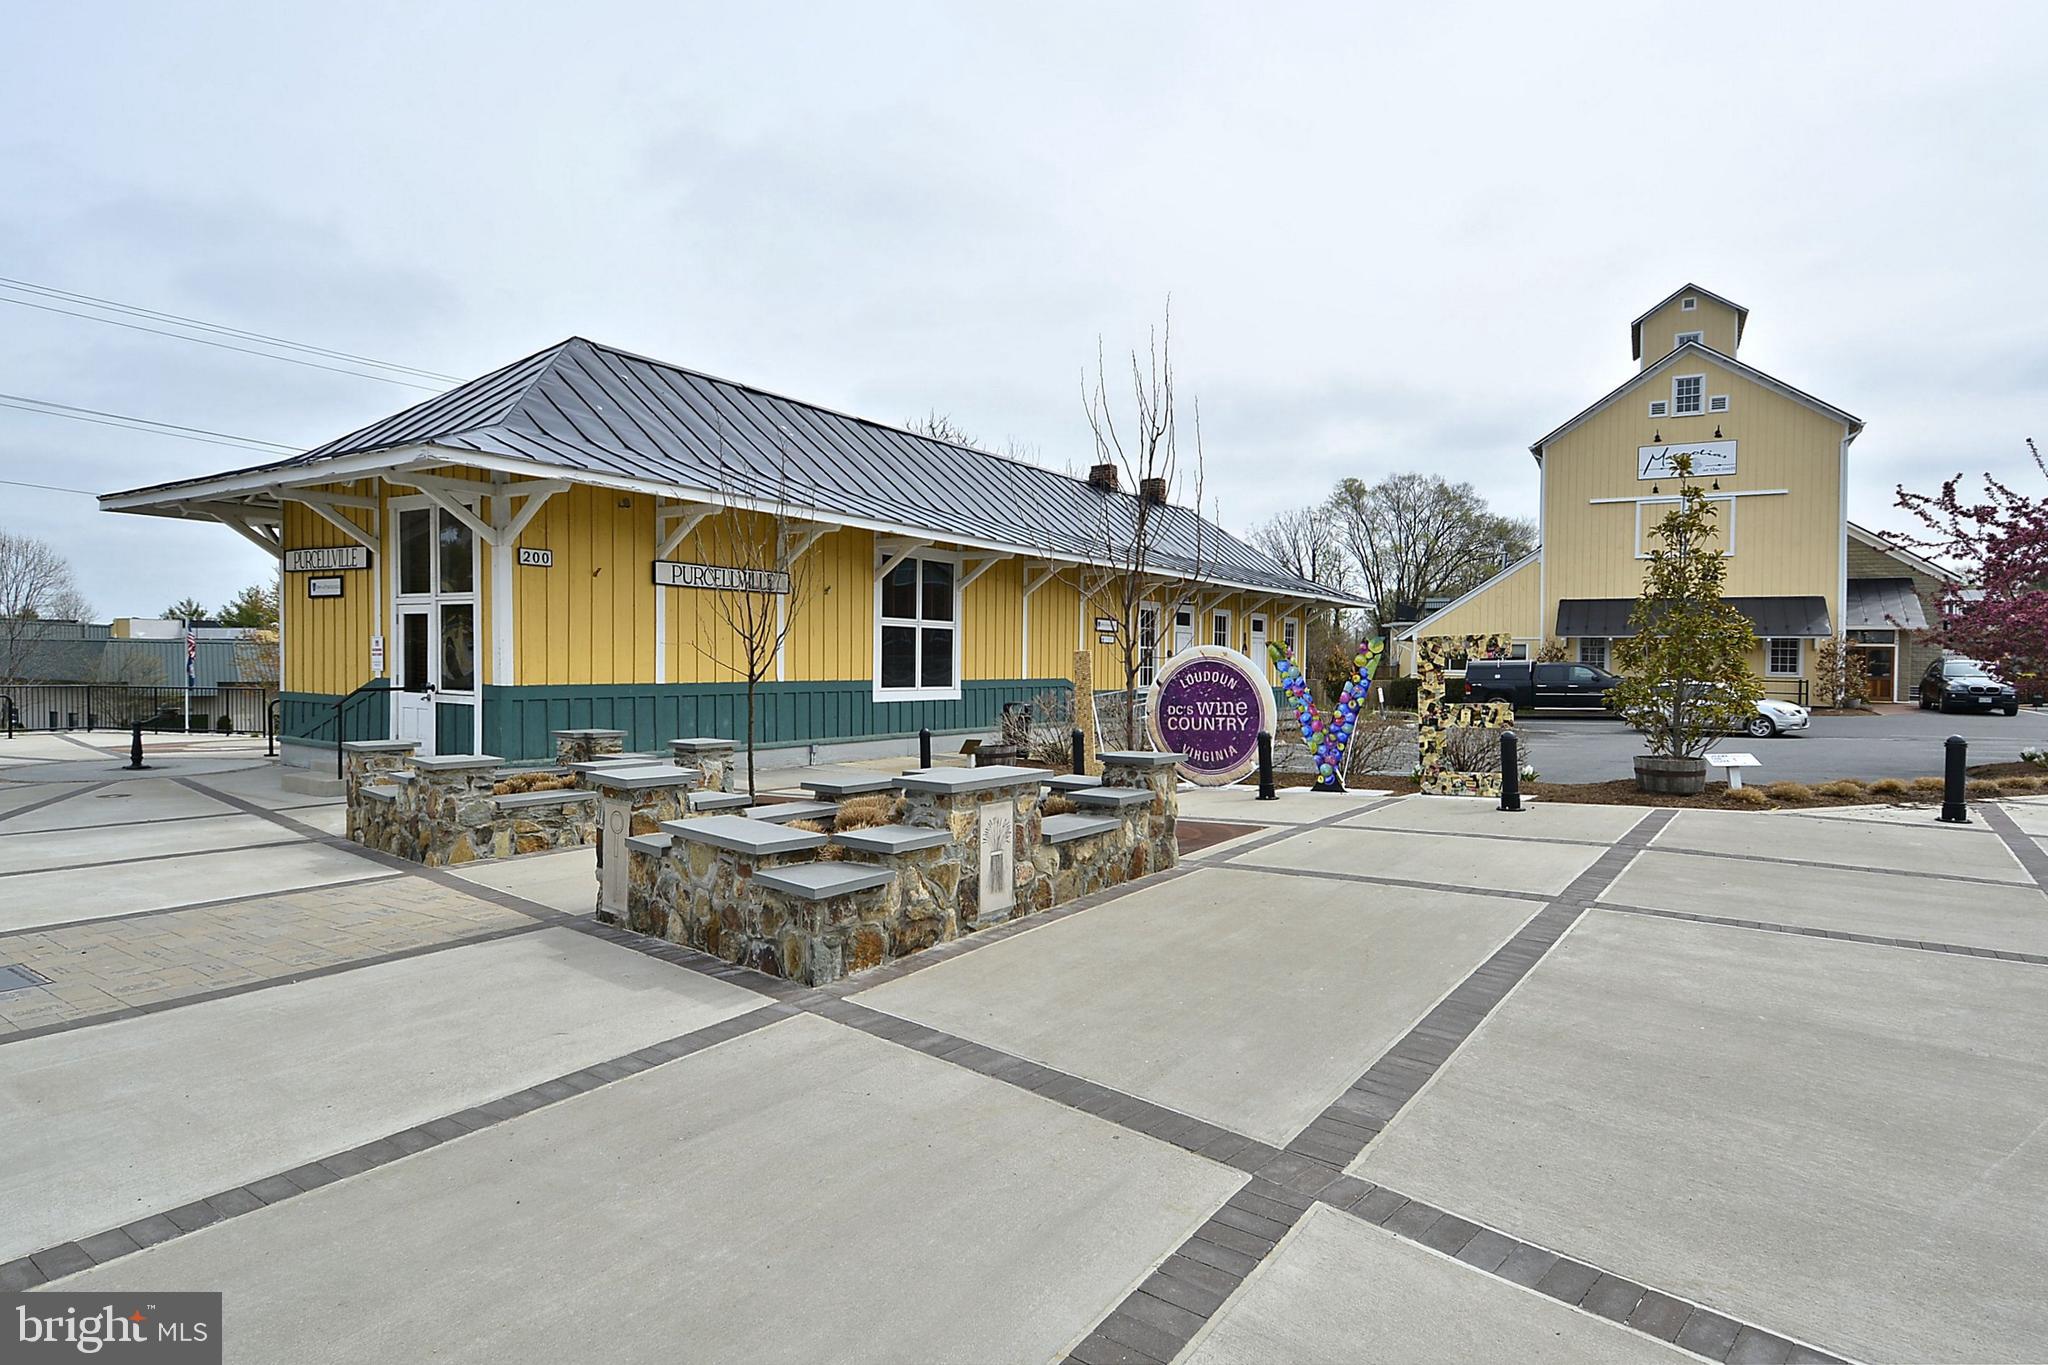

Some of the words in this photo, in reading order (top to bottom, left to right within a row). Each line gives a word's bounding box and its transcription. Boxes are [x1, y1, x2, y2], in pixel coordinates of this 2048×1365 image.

[294, 548, 357, 569] PURCELLVILLE
[523, 551, 549, 563] 200
[671, 565, 775, 590] PURCELLVILLE
[1180, 671, 1237, 689] LOUDOUN
[1167, 705, 1194, 715] DC'S
[1195, 697, 1248, 716] wine
[1167, 716, 1249, 731] COUNTRY
[1182, 743, 1238, 762] VIRGINIA
